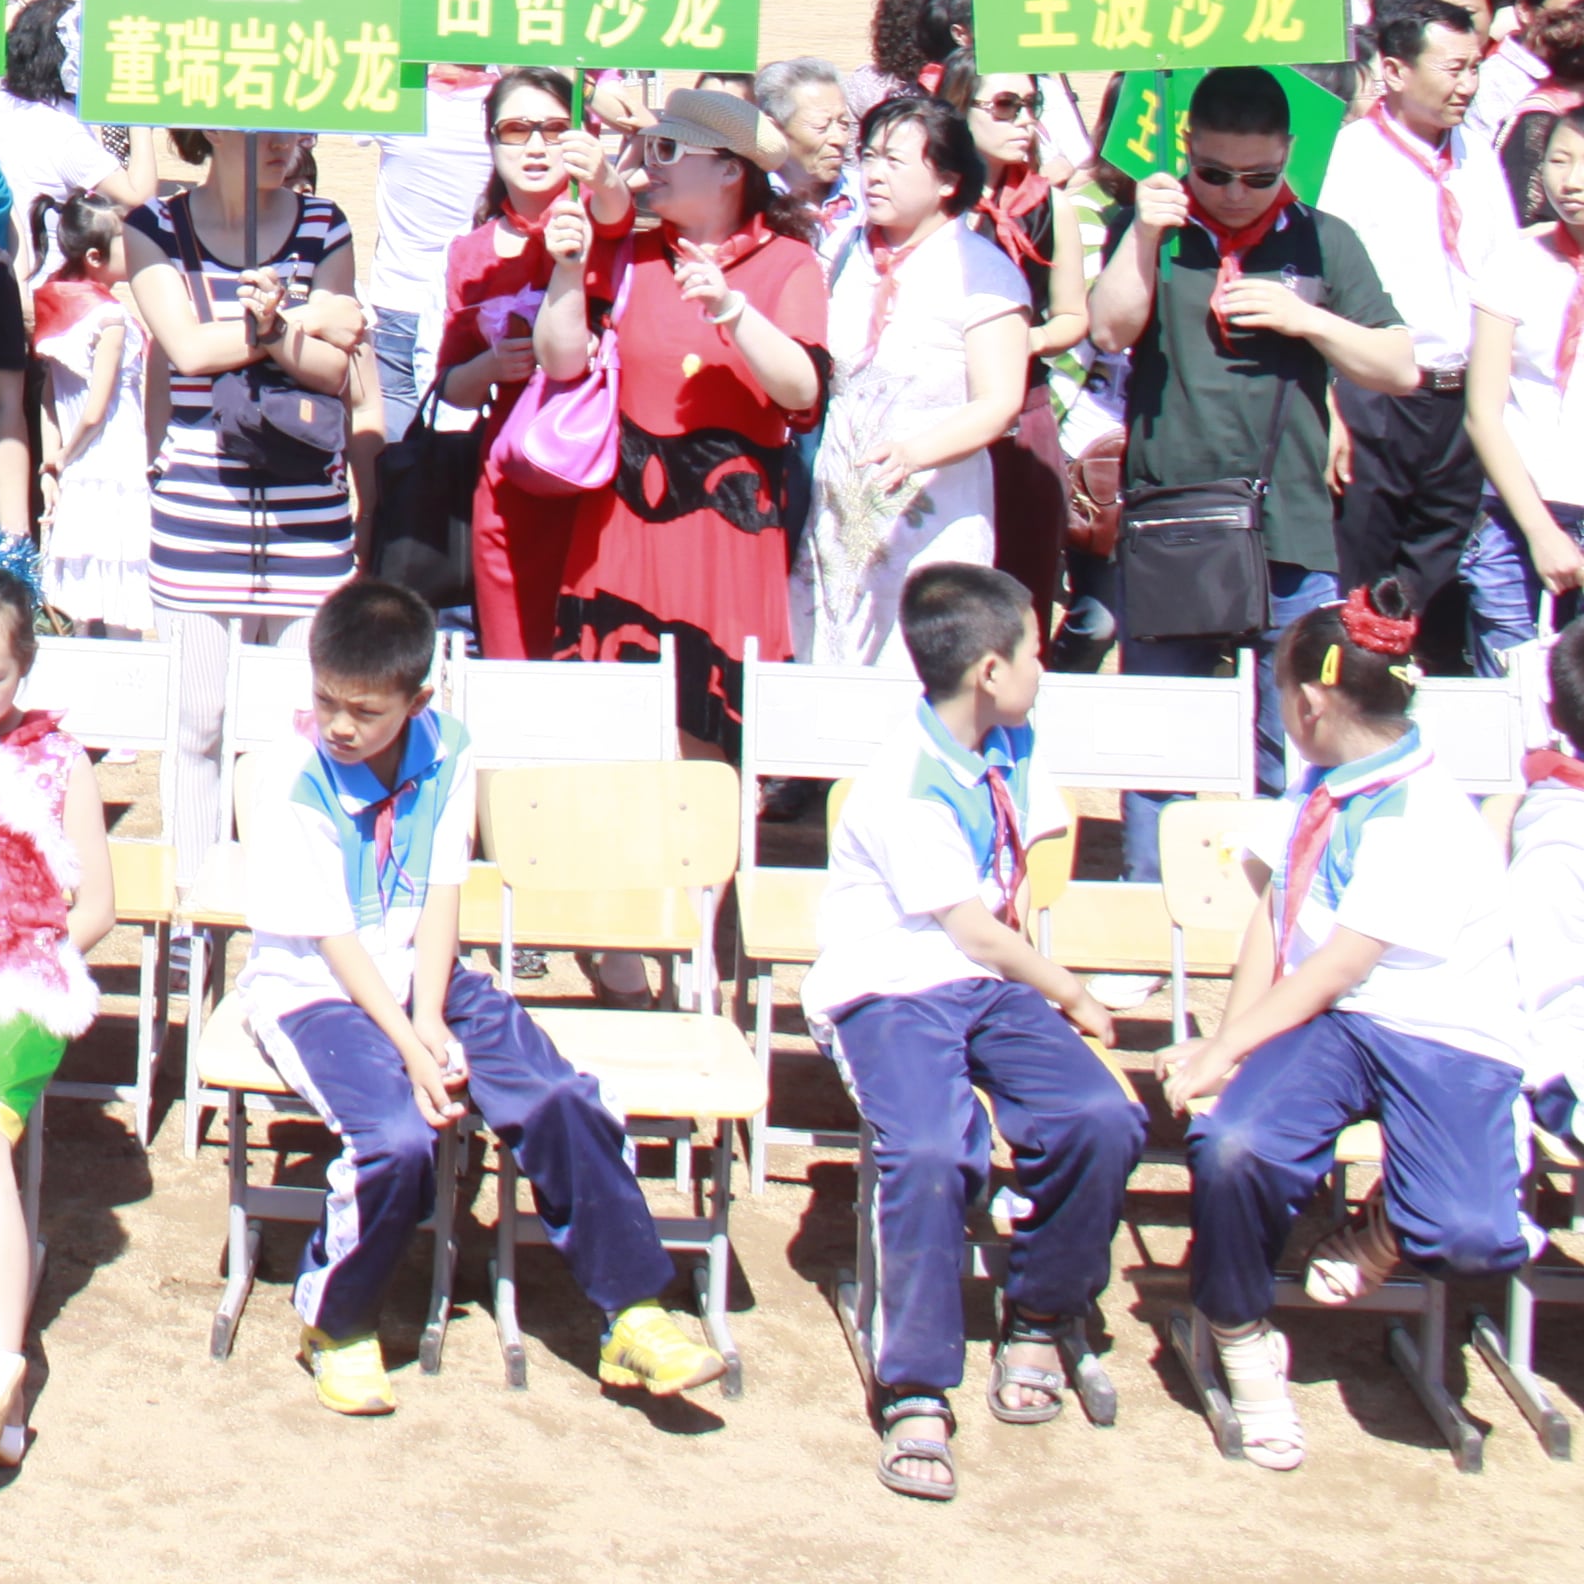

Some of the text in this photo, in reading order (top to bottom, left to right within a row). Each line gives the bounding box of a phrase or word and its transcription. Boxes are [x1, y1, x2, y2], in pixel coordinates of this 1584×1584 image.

[105, 16, 401, 112] 董瑞岩沙龙
